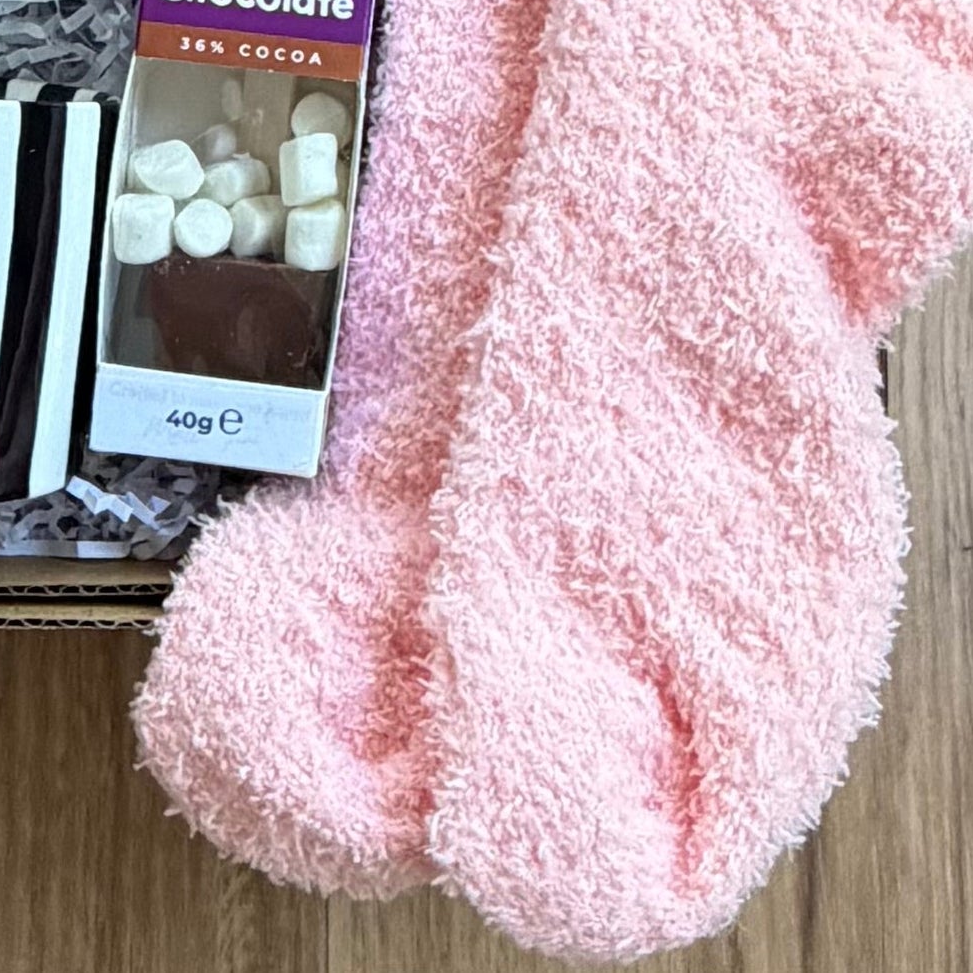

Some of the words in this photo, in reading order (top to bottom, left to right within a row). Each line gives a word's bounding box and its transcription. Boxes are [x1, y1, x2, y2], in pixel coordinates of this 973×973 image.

[180, 37, 224, 54] 36%
[239, 43, 322, 66] COCOA
[165, 409, 213, 435] 40g
